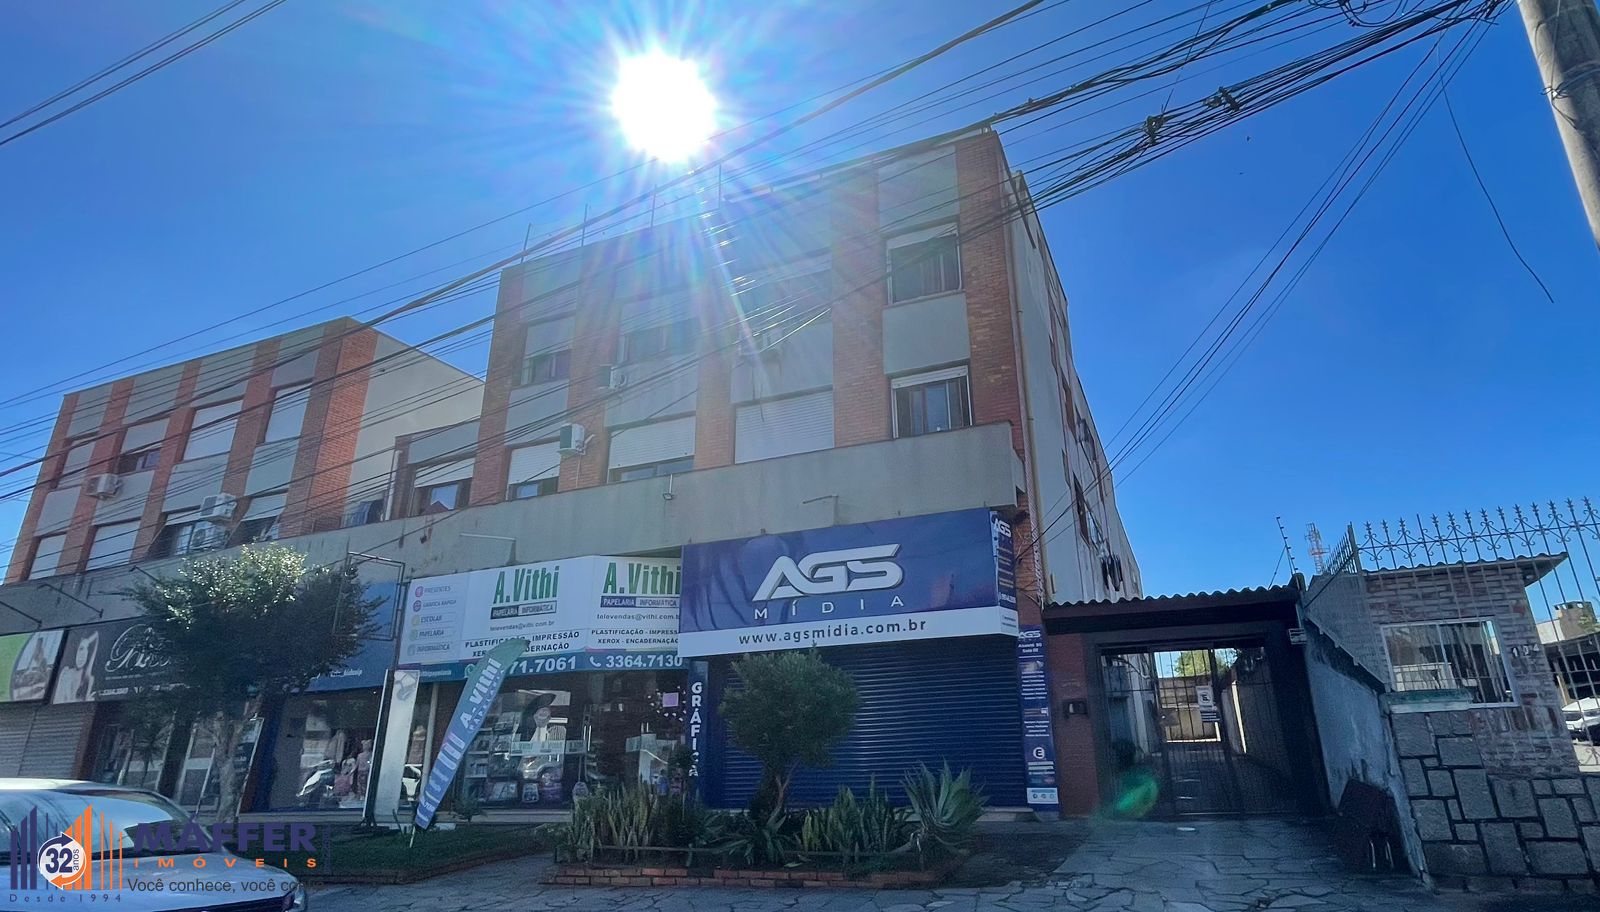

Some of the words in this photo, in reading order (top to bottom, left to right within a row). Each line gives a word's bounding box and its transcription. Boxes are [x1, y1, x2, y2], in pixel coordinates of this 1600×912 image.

[493, 567, 560, 604] A.Vithi
[602, 562, 682, 595] A.Vithi
[752, 543, 904, 602] AGS
[603, 597, 635, 606] PAPELARIA
[754, 594, 904, 620] MÍDIA
[597, 613, 680, 621] televendas@vithi.com.b
[532, 631, 580, 642] IMPRESSÃO
[738, 618, 927, 645] www.agsmidia.com.br
[605, 655, 683, 668] 3364.7130
[689, 682, 703, 777] GRÁFICA
